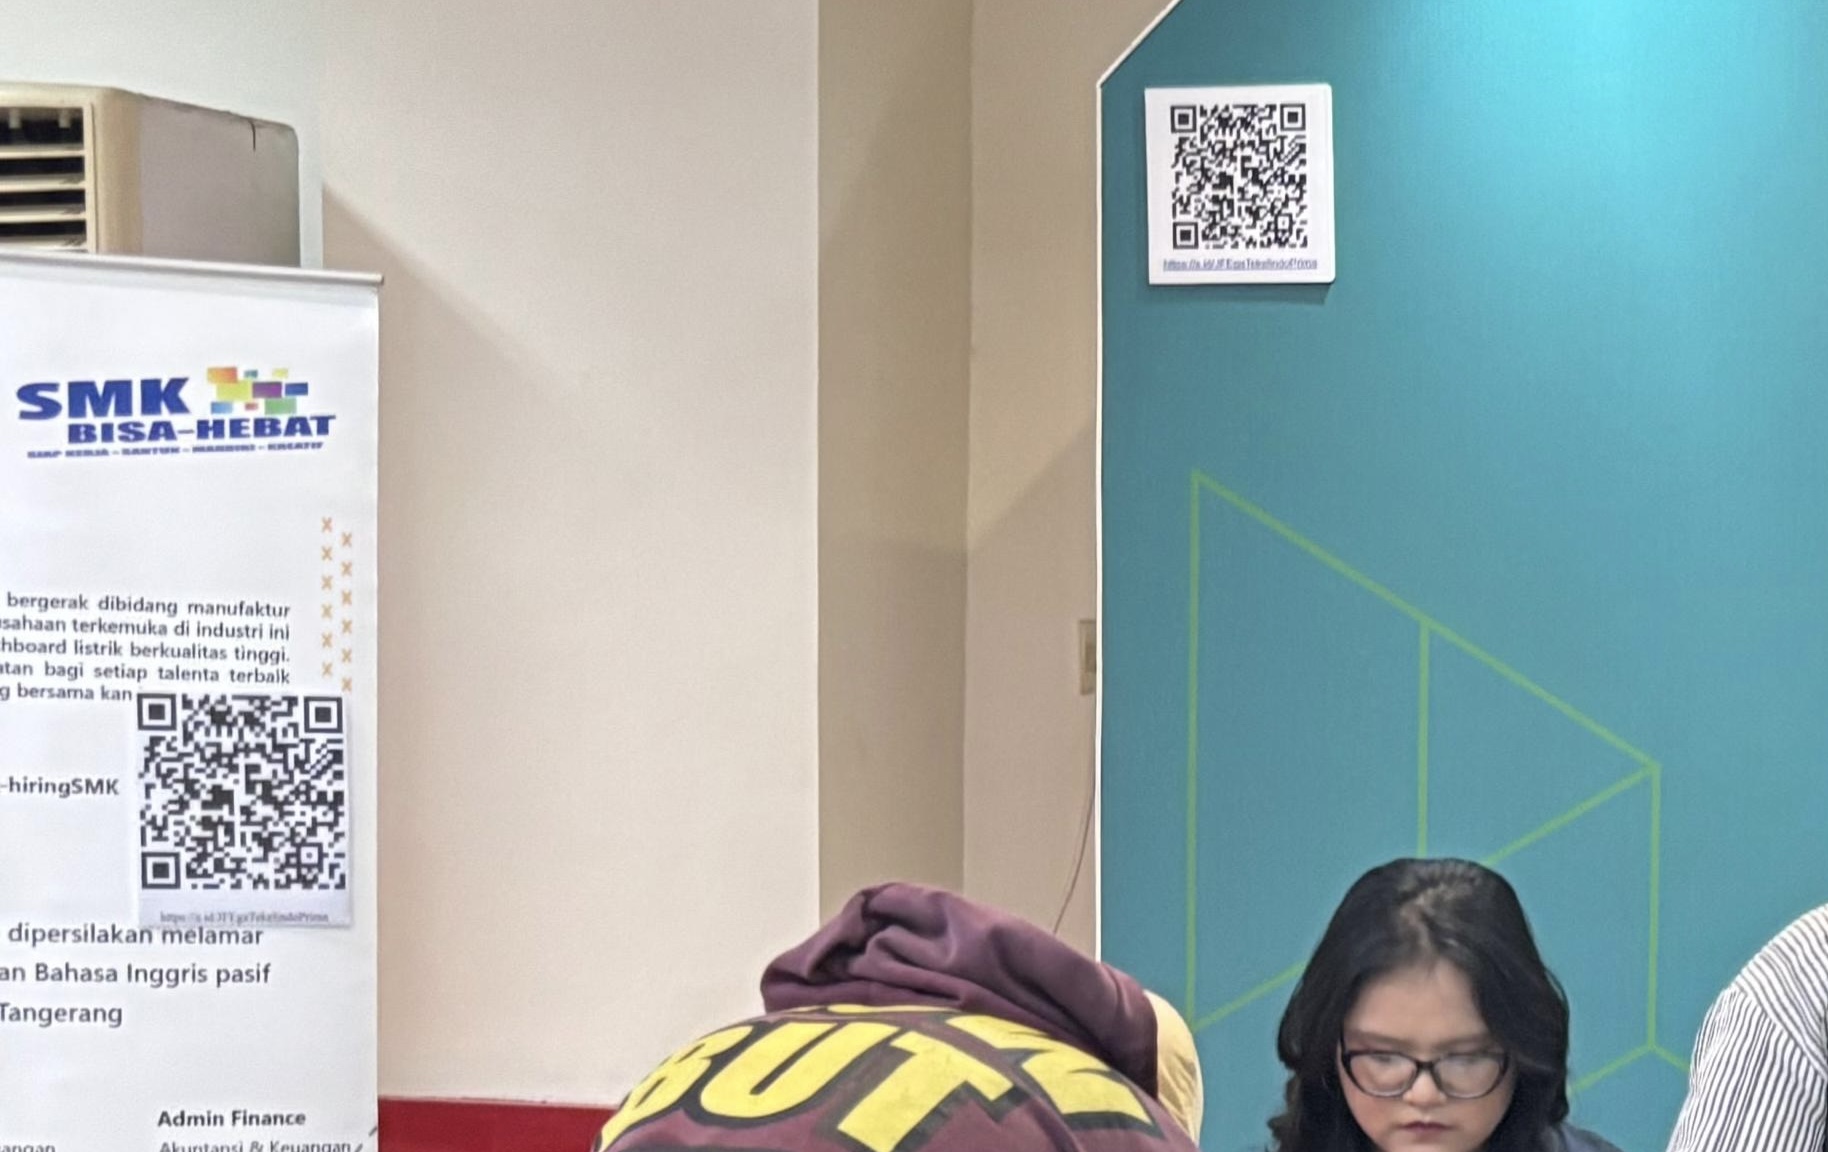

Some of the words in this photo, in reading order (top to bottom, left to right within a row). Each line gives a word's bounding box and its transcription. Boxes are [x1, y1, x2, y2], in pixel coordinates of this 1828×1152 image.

[16, 377, 191, 420] SMK
[68, 415, 337, 444] BISA-HEBAT
[7, 591, 88, 612] bergerak
[98, 595, 178, 617] dibidang
[188, 600, 290, 618] manufaktur
[0, 614, 66, 632] sahaan
[72, 617, 168, 636] terkemuka
[174, 620, 189, 637] di
[197, 620, 263, 640] industri
[269, 623, 290, 641] ini
[74, 639, 123, 656] listrik
[130, 641, 228, 660] berkualitas
[234, 645, 290, 665] tinggi.
[45, 660, 84, 681] bagi
[94, 663, 148, 683] setiap
[158, 665, 219, 681] talenta
[229, 667, 290, 685] terbaik
[17, 682, 94, 700] bersama
[8, 922, 153, 947] dipersilakan
[161, 924, 264, 945] melamar
[35, 962, 118, 982] Bahasa
[127, 963, 208, 988] Inggris
[216, 962, 271, 987] pasif
[0, 1003, 123, 1028] Tangerang
[157, 1111, 224, 1127] Admin
[232, 1110, 306, 1126] Finance
